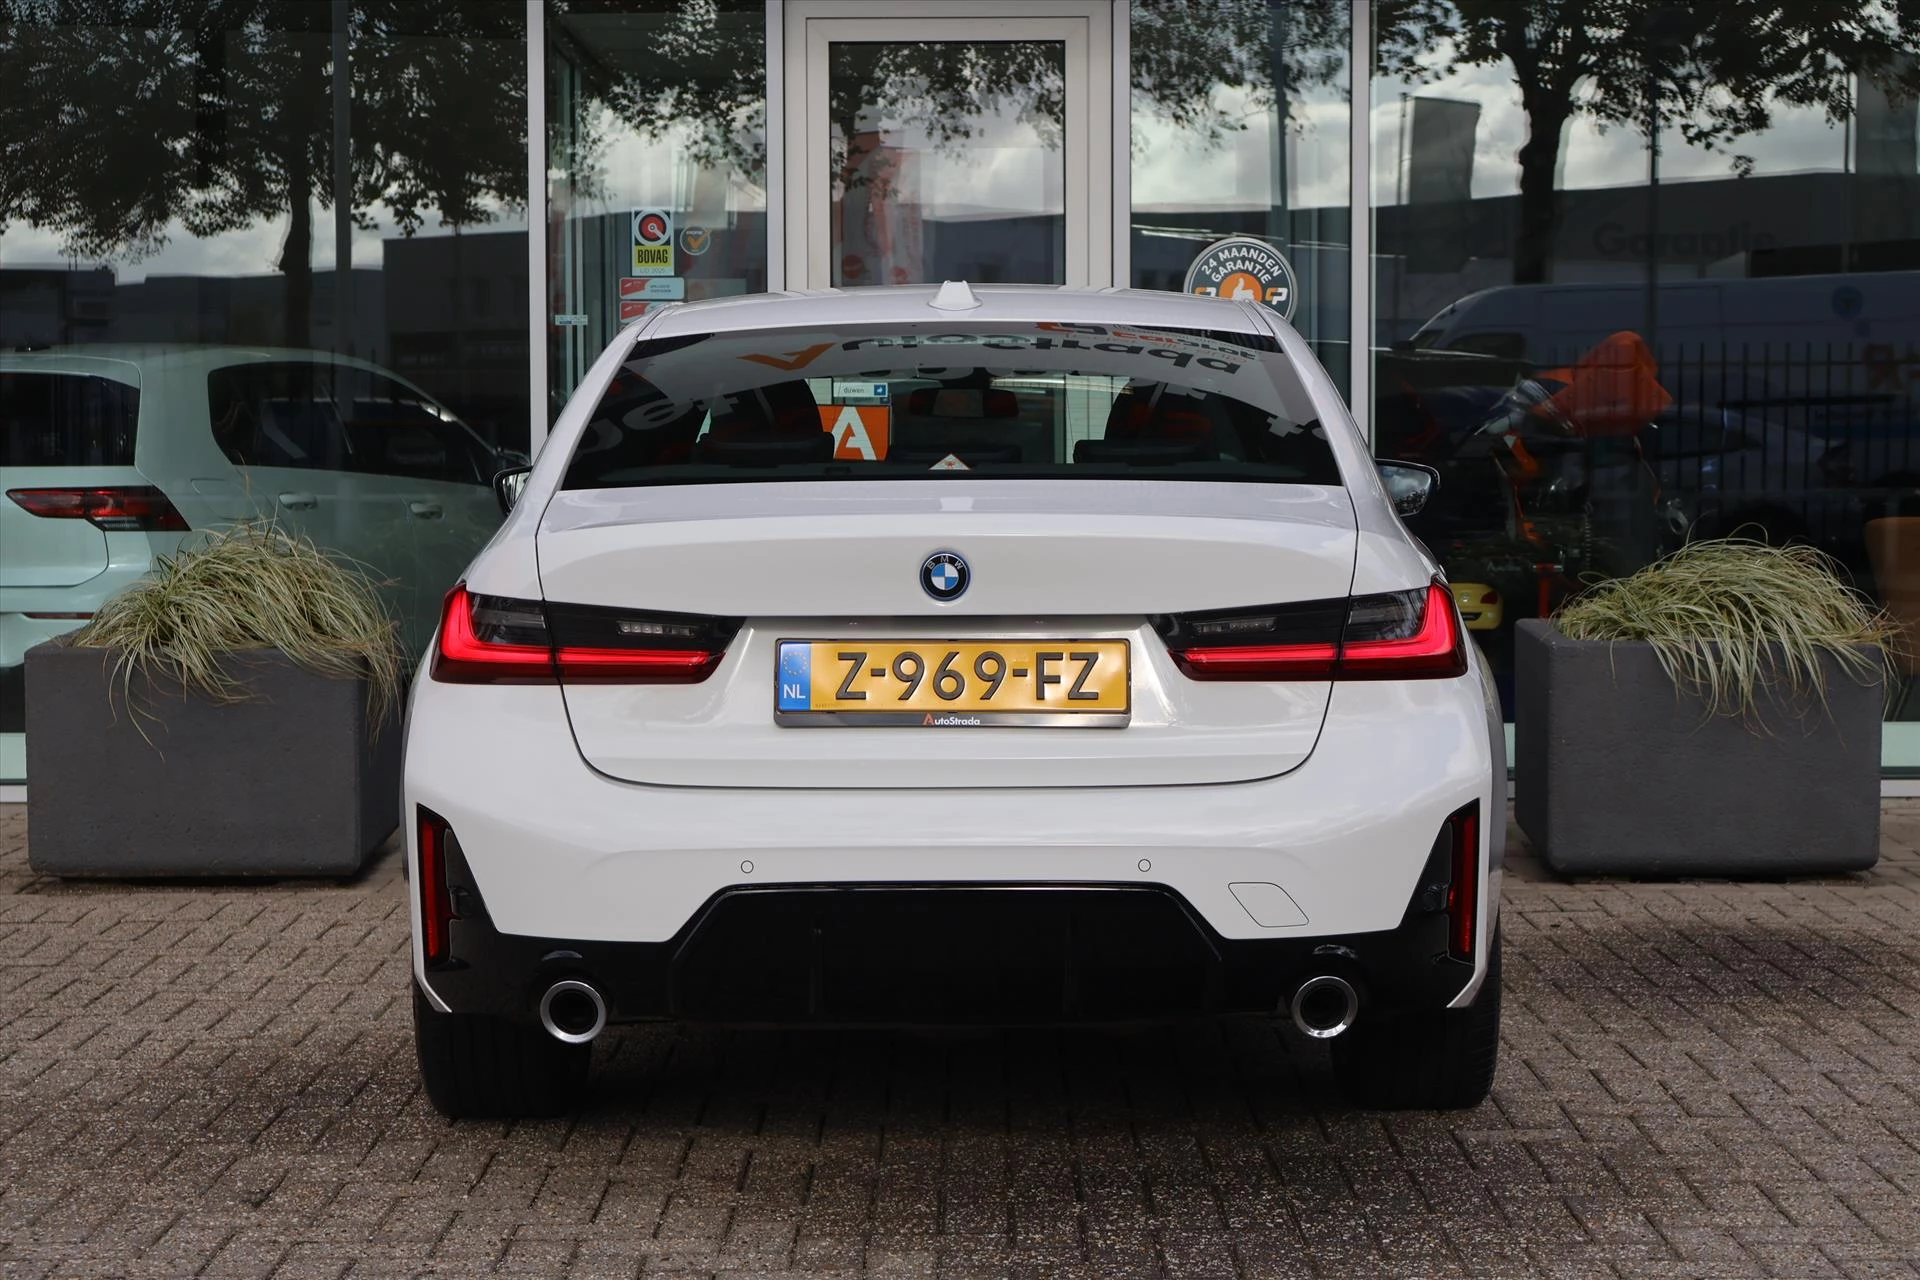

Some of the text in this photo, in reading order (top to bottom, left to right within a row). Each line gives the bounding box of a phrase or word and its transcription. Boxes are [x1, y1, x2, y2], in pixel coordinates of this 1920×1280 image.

[637, 248, 668, 264] BOVAG
[1201, 247, 1282, 277] 24 MAANDEN
[1211, 260, 1272, 284] GARANTIE
[926, 555, 964, 570] BMW
[835, 650, 1100, 701] Z-969-FZ
[783, 684, 805, 699] NL
[922, 712, 981, 726] AutoStrada
